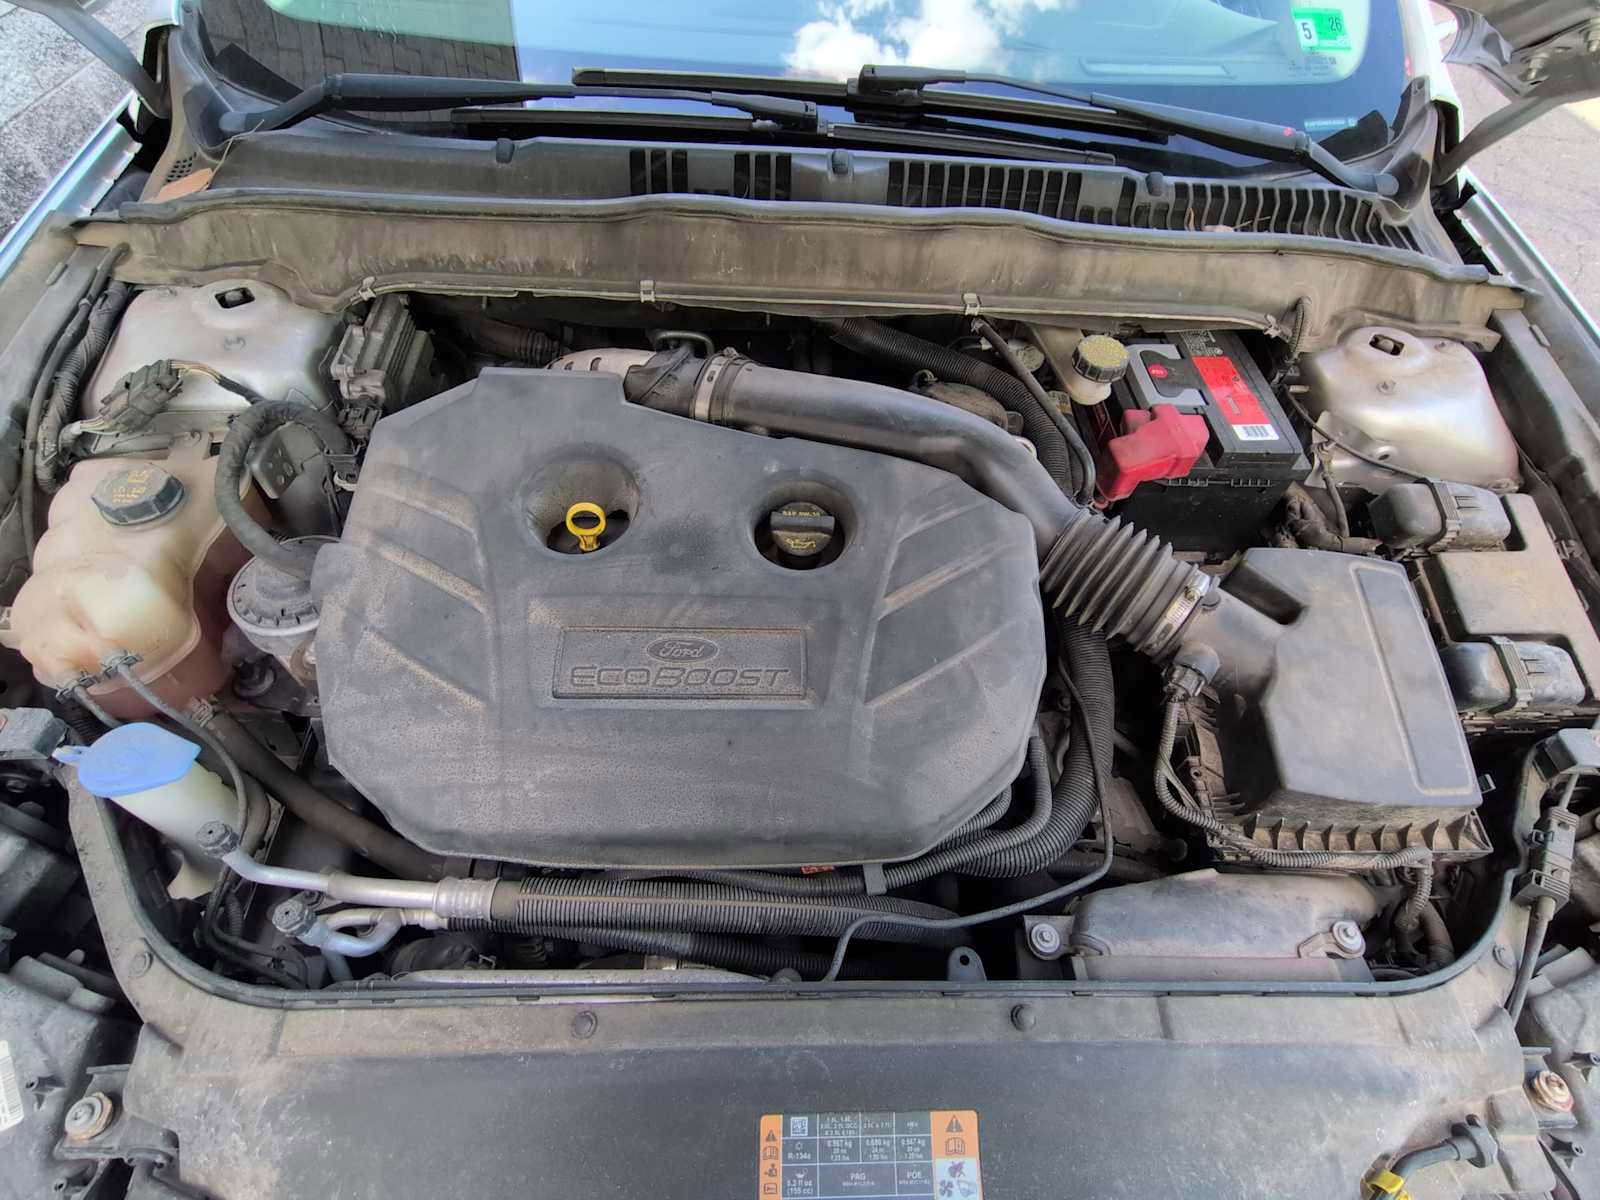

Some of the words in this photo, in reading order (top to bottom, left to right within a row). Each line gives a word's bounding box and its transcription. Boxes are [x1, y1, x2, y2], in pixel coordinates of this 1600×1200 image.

[1301, 22, 1312, 40] 5
[1328, 15, 1342, 32] 26
[659, 638, 705, 658] Ford
